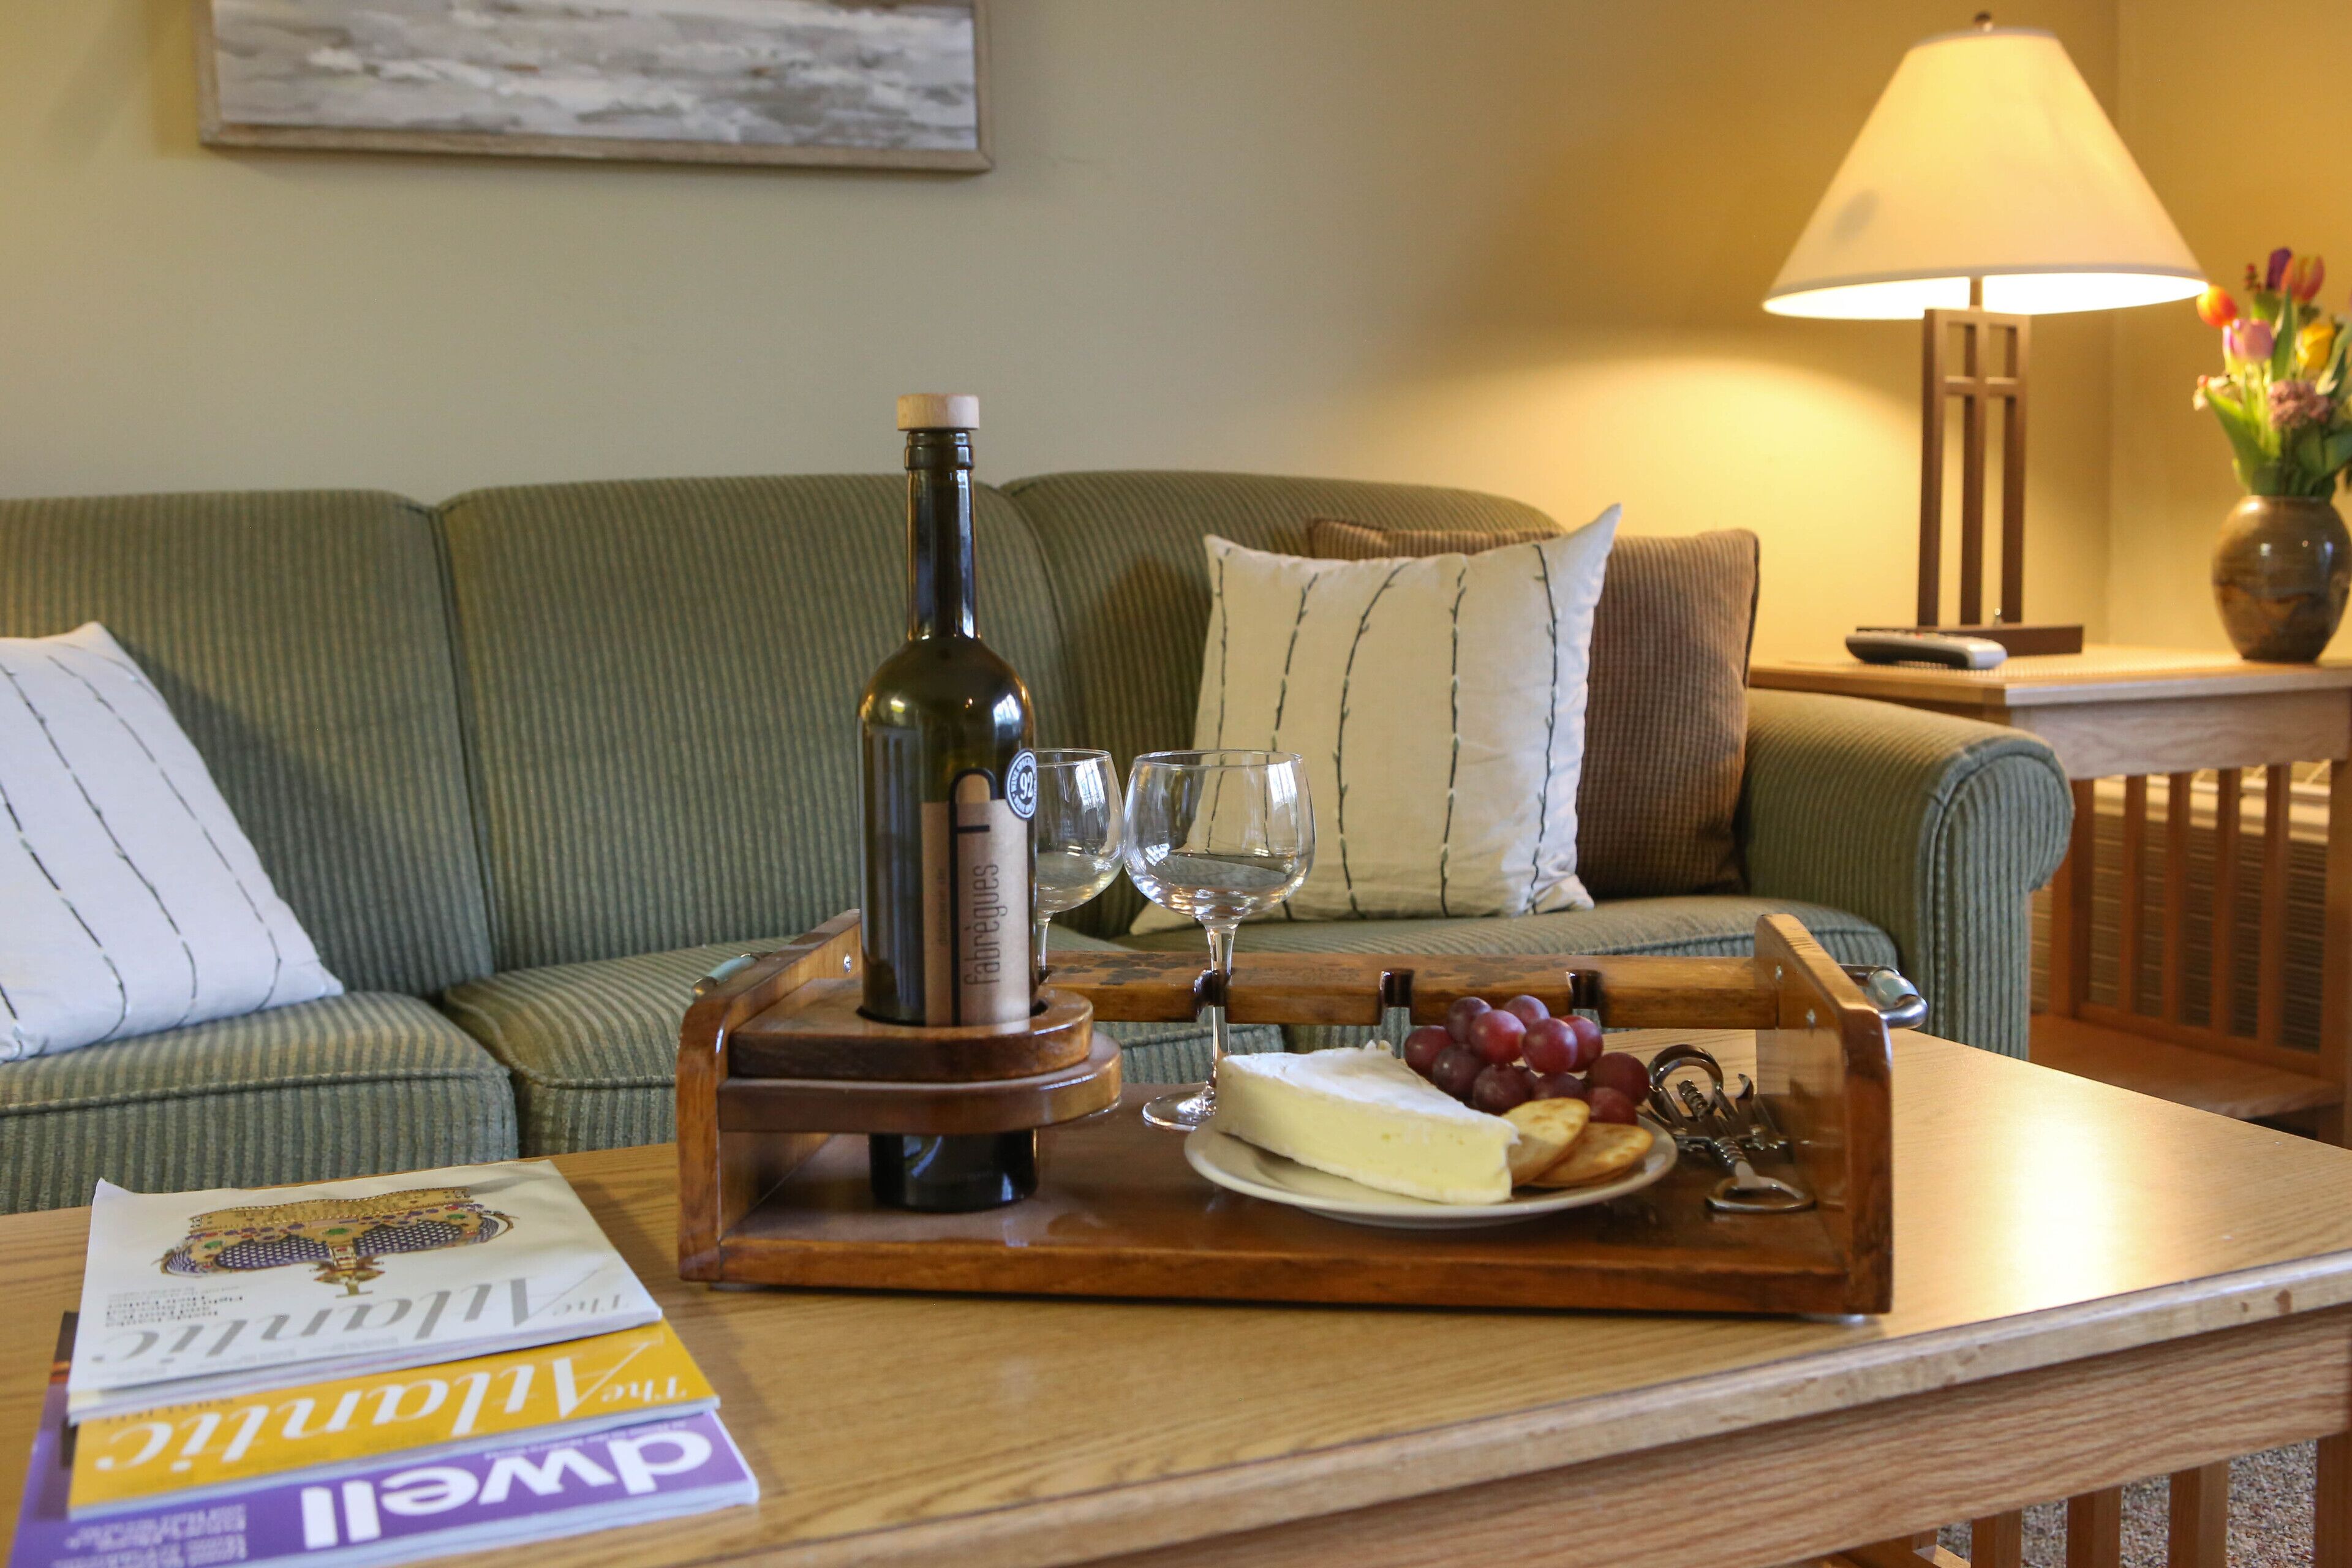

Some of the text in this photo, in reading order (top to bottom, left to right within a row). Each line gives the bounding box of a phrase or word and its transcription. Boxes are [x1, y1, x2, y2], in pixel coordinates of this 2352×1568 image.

[1020, 771, 1033, 800] 92
[964, 864, 1008, 986] fabrègues
[91, 1261, 608, 1364] Atlantic
[552, 1294, 632, 1318] The
[96, 1338, 662, 1472] Atlantic
[601, 1375, 687, 1404] The
[301, 1430, 713, 1550] dwell
